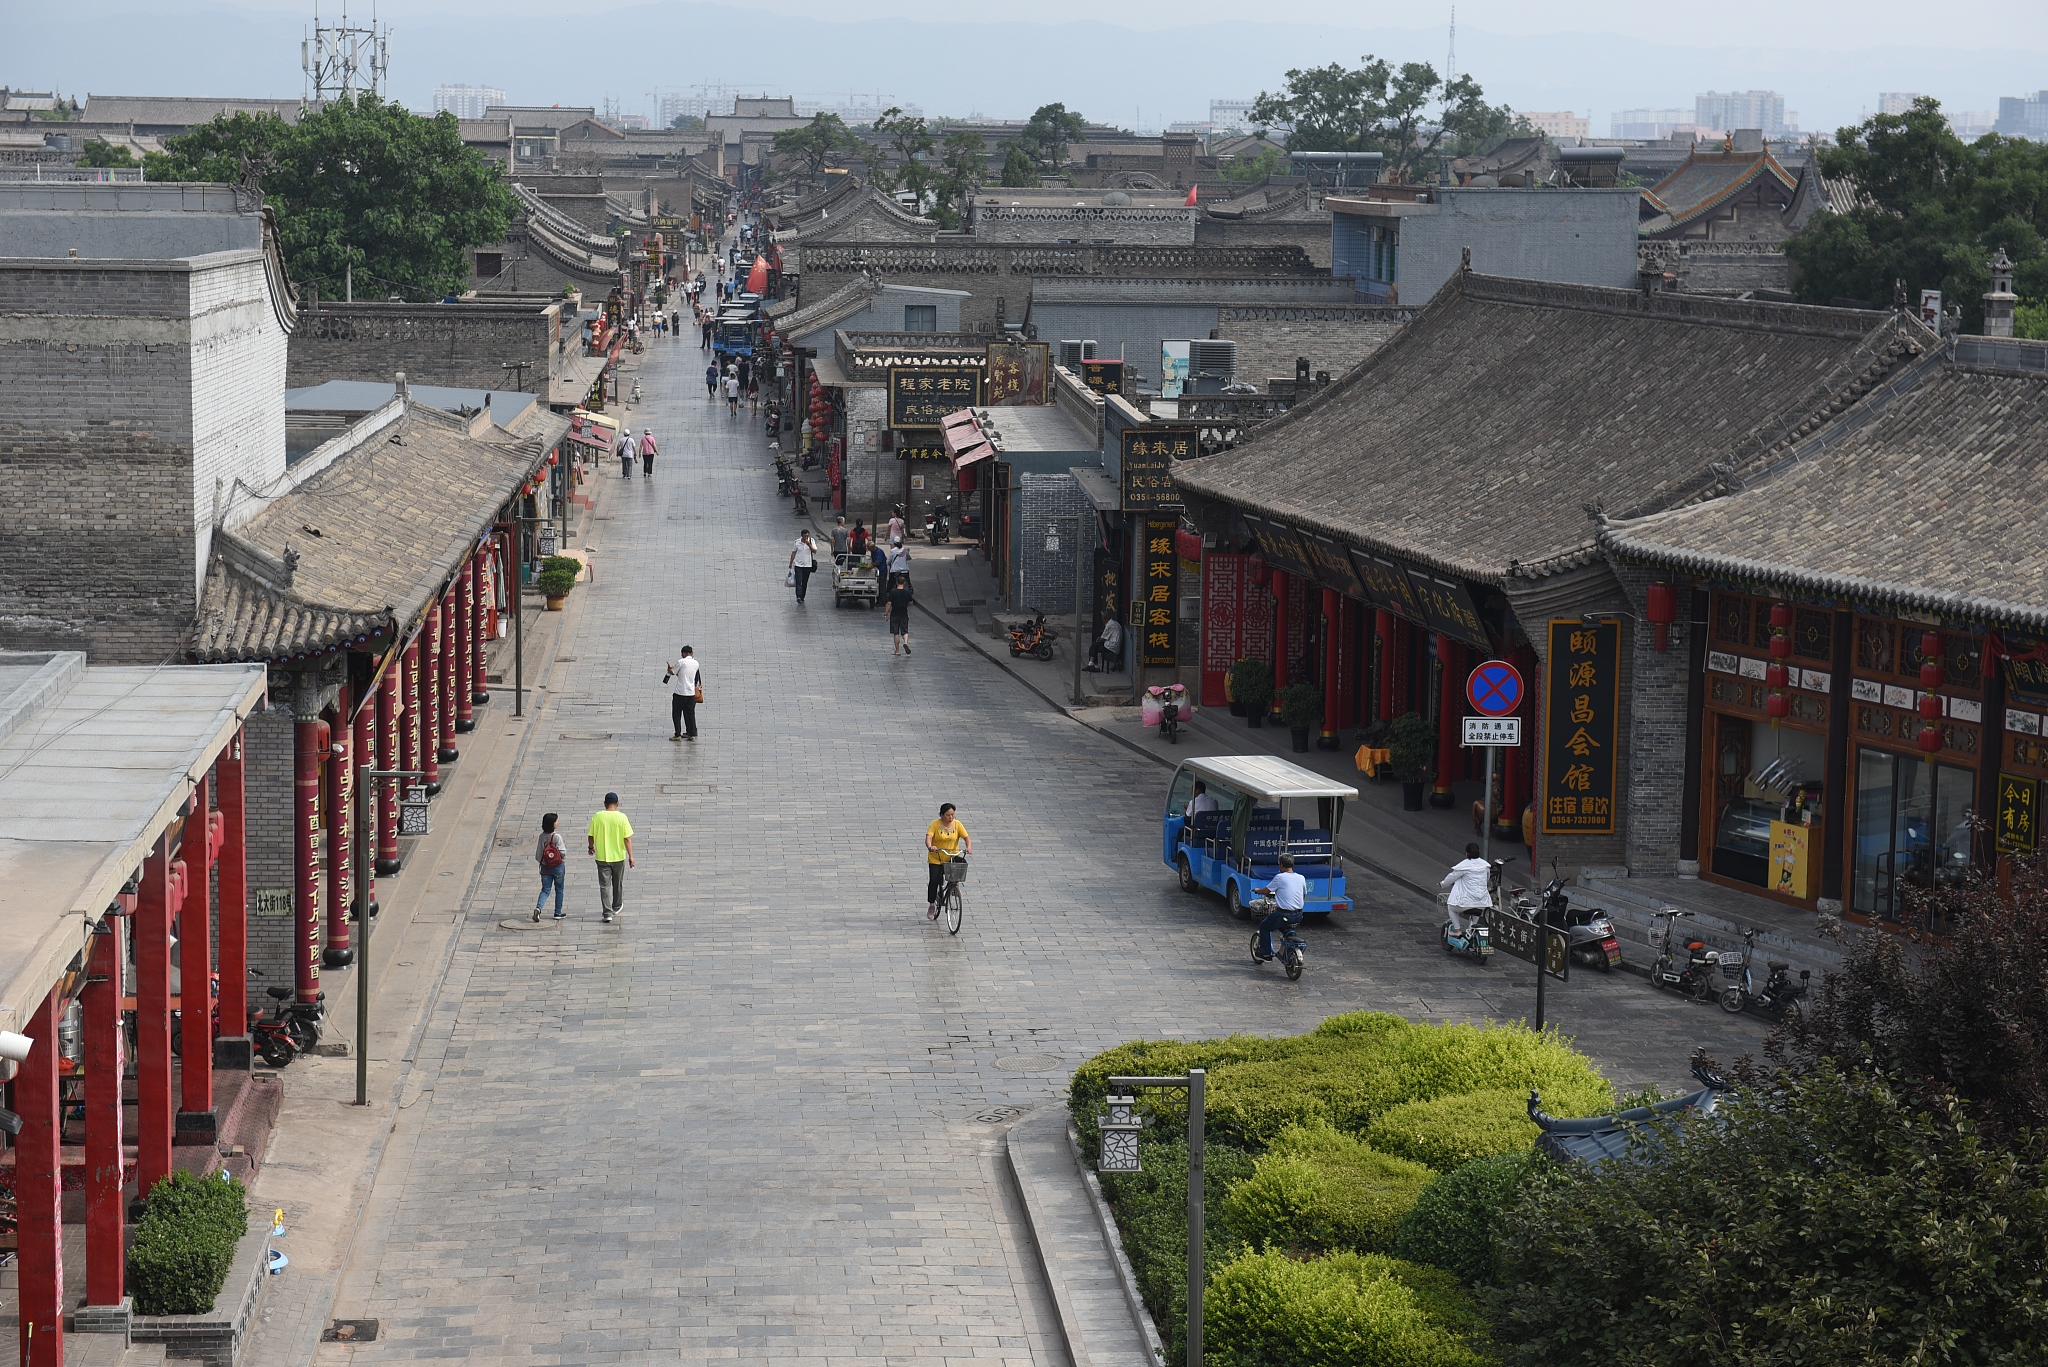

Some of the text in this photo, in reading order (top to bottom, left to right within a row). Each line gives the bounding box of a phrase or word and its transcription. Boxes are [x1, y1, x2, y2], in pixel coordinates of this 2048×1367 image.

[900, 378, 971, 391] 程家老院
[1131, 441, 1188, 455] 缘来居
[1149, 537, 1173, 649] 缘来居客栈
[1561, 629, 1601, 792] 颐源昌会馆
[1468, 732, 1515, 741] 全段禁止停车
[2003, 783, 2031, 806] 今日
[1550, 796, 1609, 815] 住宿 餐饮
[1551, 816, 1607, 824] 0354-7337000
[257, 894, 292, 912] 北大街118号
[1498, 921, 1528, 944] 北大街
